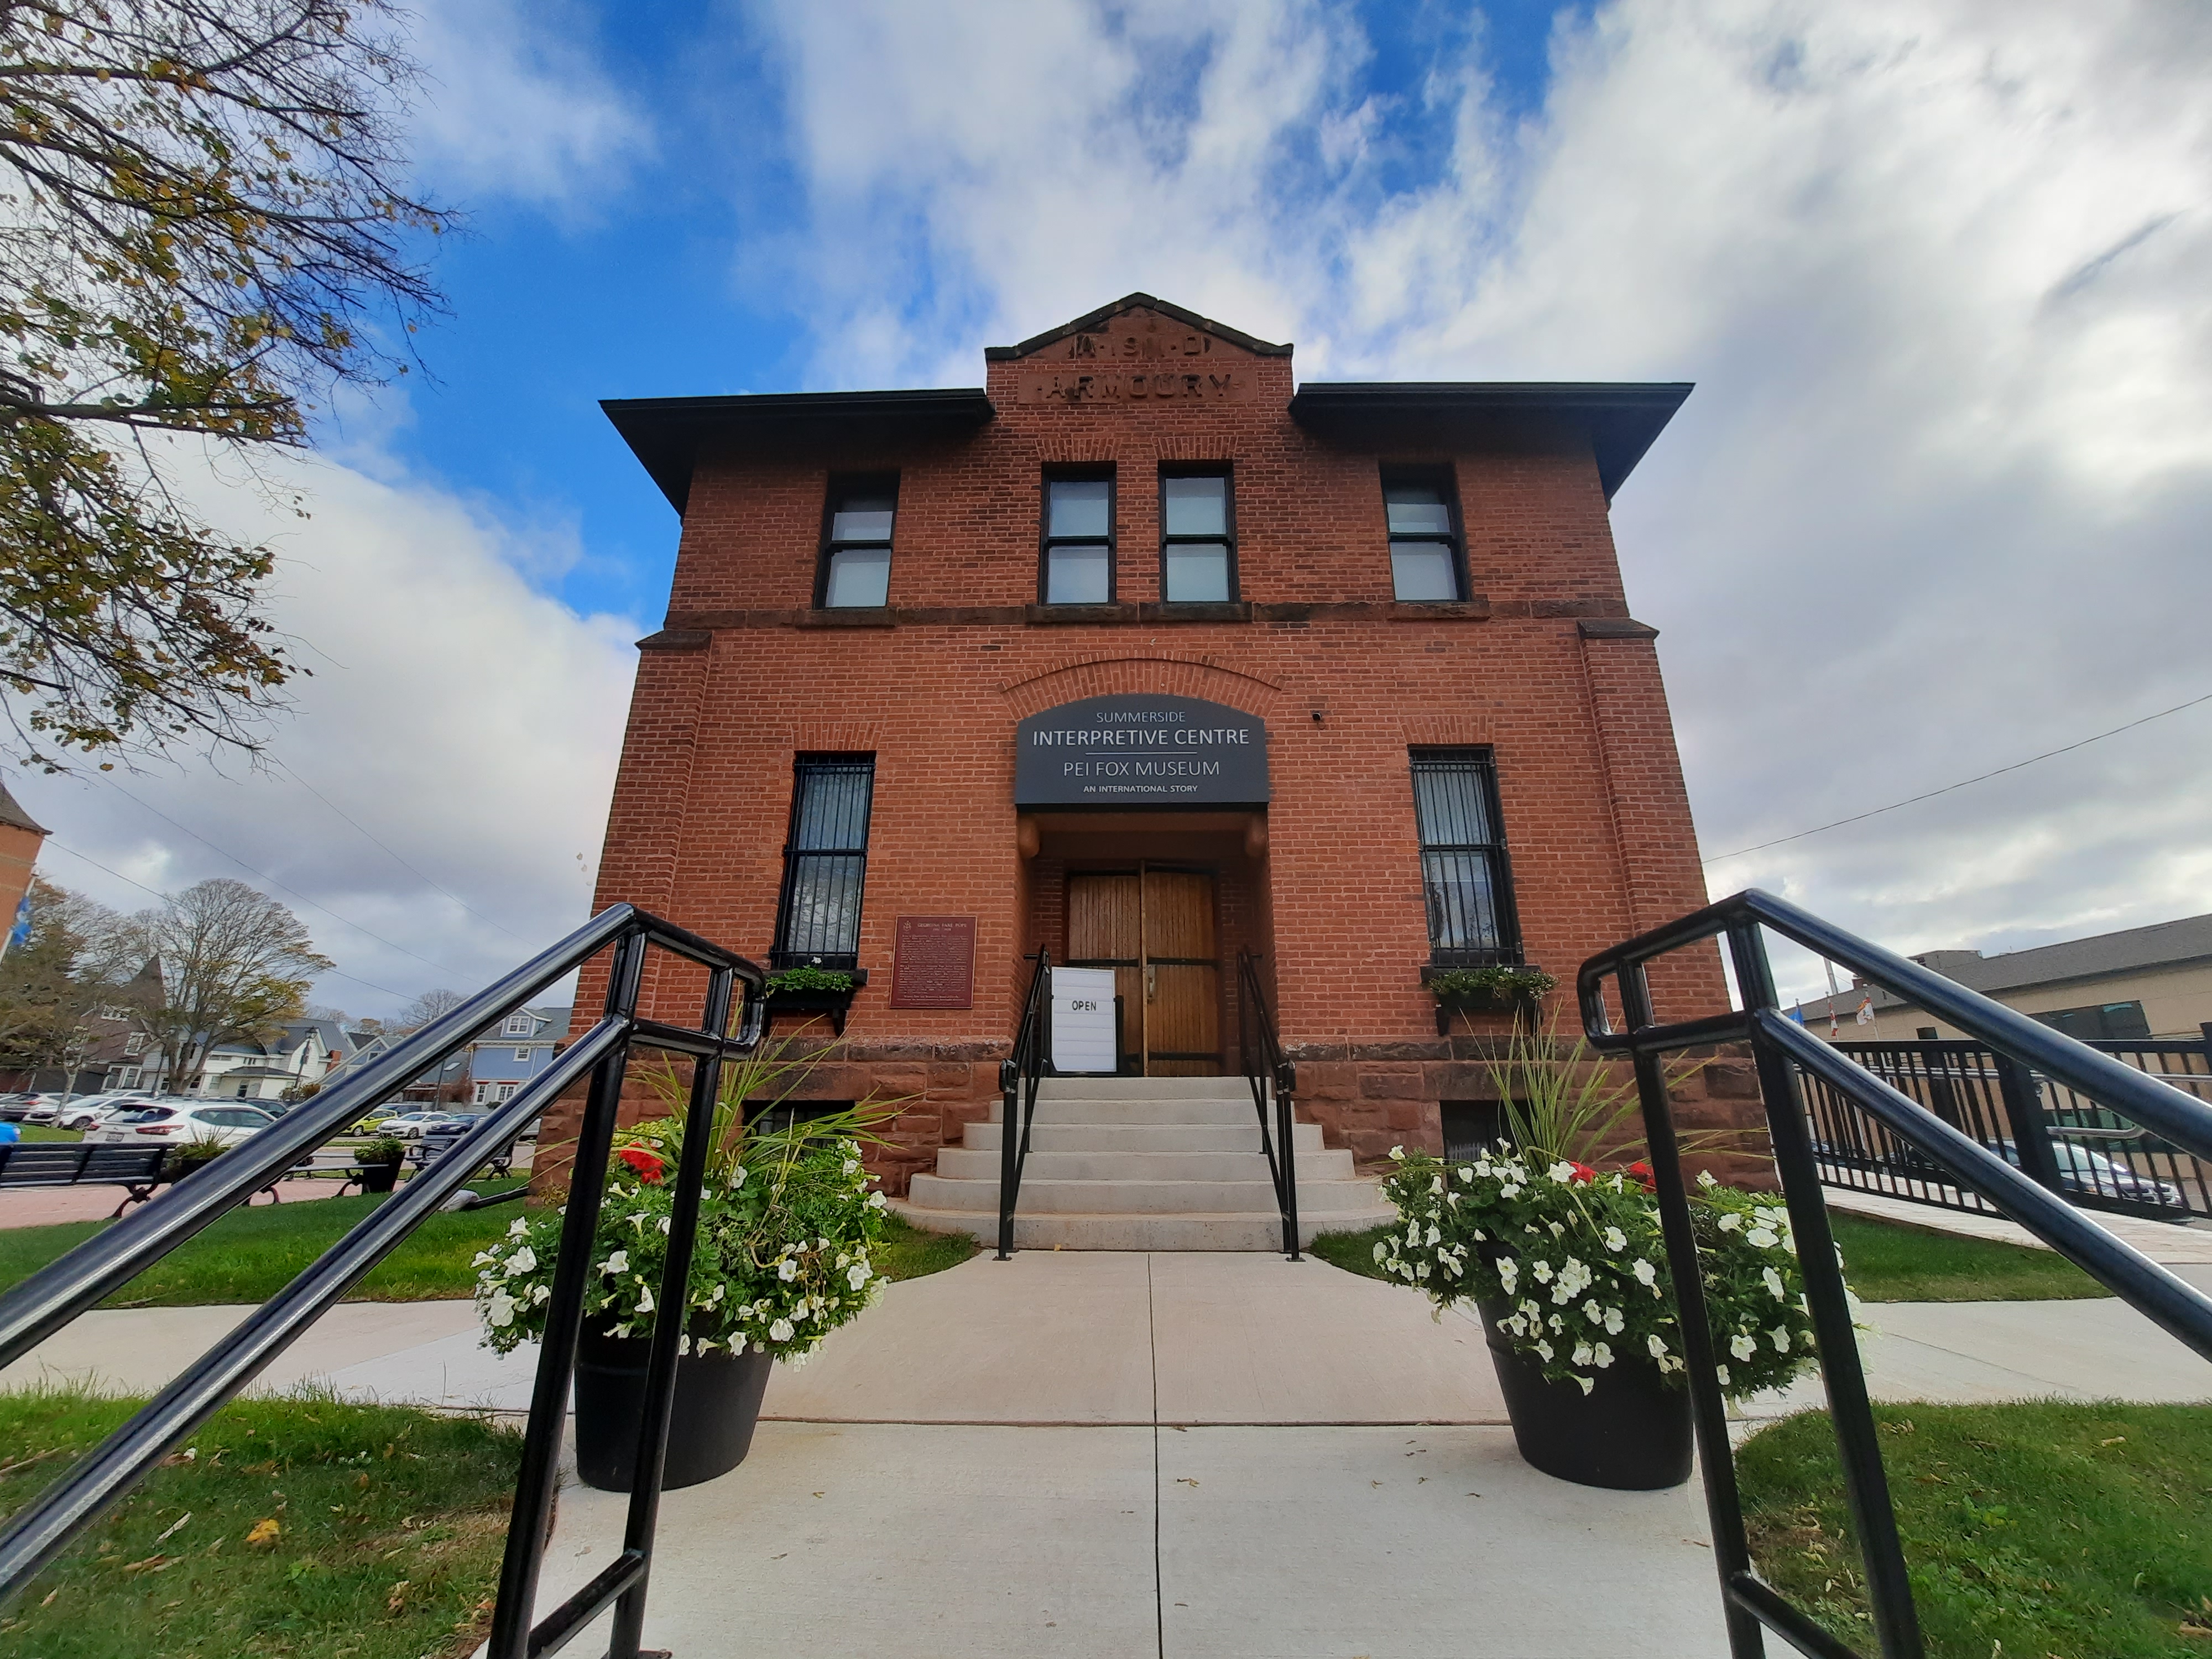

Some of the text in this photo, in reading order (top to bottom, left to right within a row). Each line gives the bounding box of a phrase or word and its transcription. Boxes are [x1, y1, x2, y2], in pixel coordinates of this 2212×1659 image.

[1096, 711, 1186, 723] SUMMERSIDE
[1032, 729, 1250, 746] INTERPRETIVE CENTRE
[1063, 761, 1220, 776] PEI FOX MUSEUM
[1071, 1000, 1097, 1011] OPEN
